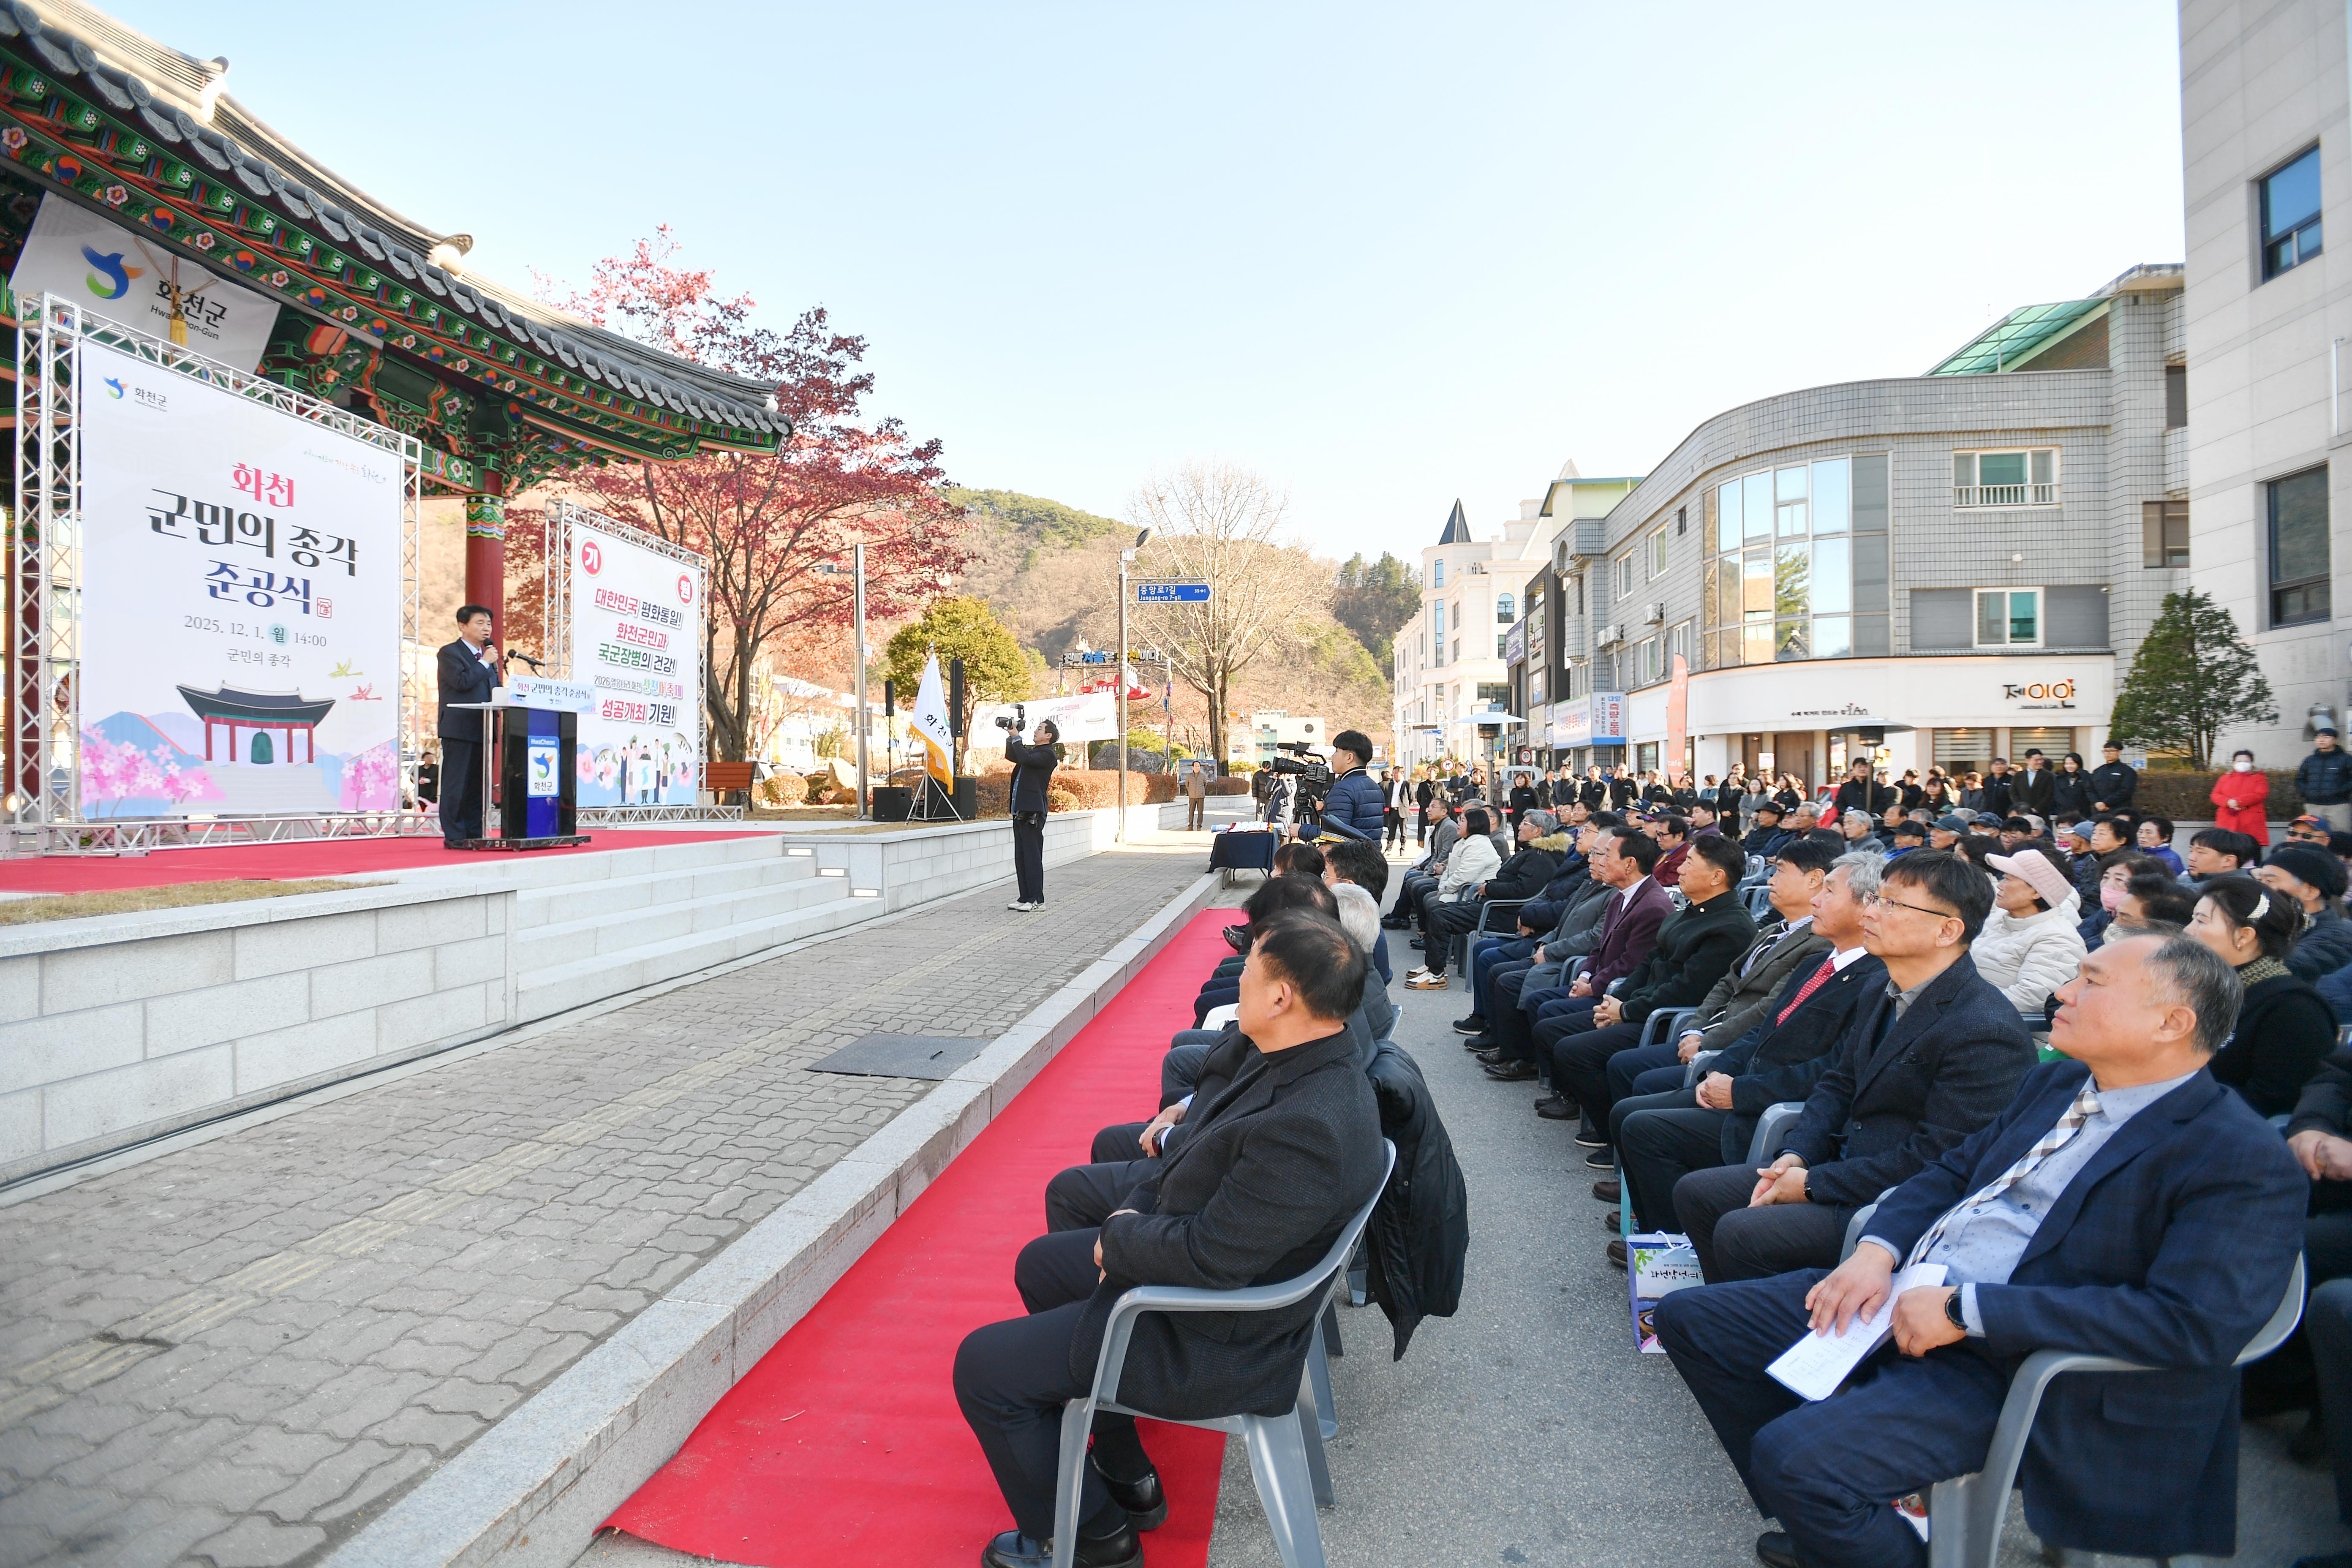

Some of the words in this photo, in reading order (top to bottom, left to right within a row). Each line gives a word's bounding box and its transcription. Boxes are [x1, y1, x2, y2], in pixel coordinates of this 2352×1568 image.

[155, 280, 227, 329] 화천군
[150, 305, 220, 340] Hwaeon-Gun
[135, 387, 168, 407] 화천군
[231, 462, 294, 508] 화천
[145, 488, 275, 559] 군민의
[288, 525, 359, 577] 종각
[584, 546, 599, 570] 기
[680, 580, 691, 600] 원
[204, 560, 311, 615] 준공식
[1140, 585, 1176, 595] 중앙로7길
[594, 588, 639, 615] 대한민국
[641, 601, 682, 627] 평화통일!
[184, 615, 224, 634] 2025.
[230, 623, 249, 637] 12.
[254, 626, 264, 640] 1.
[271, 627, 285, 643] 월
[294, 632, 327, 647] 14:00
[616, 622, 667, 649] 화천군민과
[226, 648, 264, 665] 군민의
[268, 653, 291, 668] 종각
[598, 642, 651, 669] 국군장병의
[653, 655, 675, 674] 건강!
[1063, 652, 1083, 663] 진짜
[1083, 651, 1115, 663] 겨울은
[517, 682, 529, 692] 화천
[531, 682, 552, 695] 군민의
[555, 686, 567, 697] 종각
[569, 688, 587, 700] 준공식
[594, 675, 610, 686] 2026
[611, 678, 631, 689] 얼음나라
[632, 681, 641, 691] 화천
[642, 678, 682, 697] 산천어축제
[2002, 681, 2077, 708] 제이안
[602, 699, 646, 721] 성공개최
[648, 703, 675, 724] 기원!
[534, 781, 553, 791] 화천군
